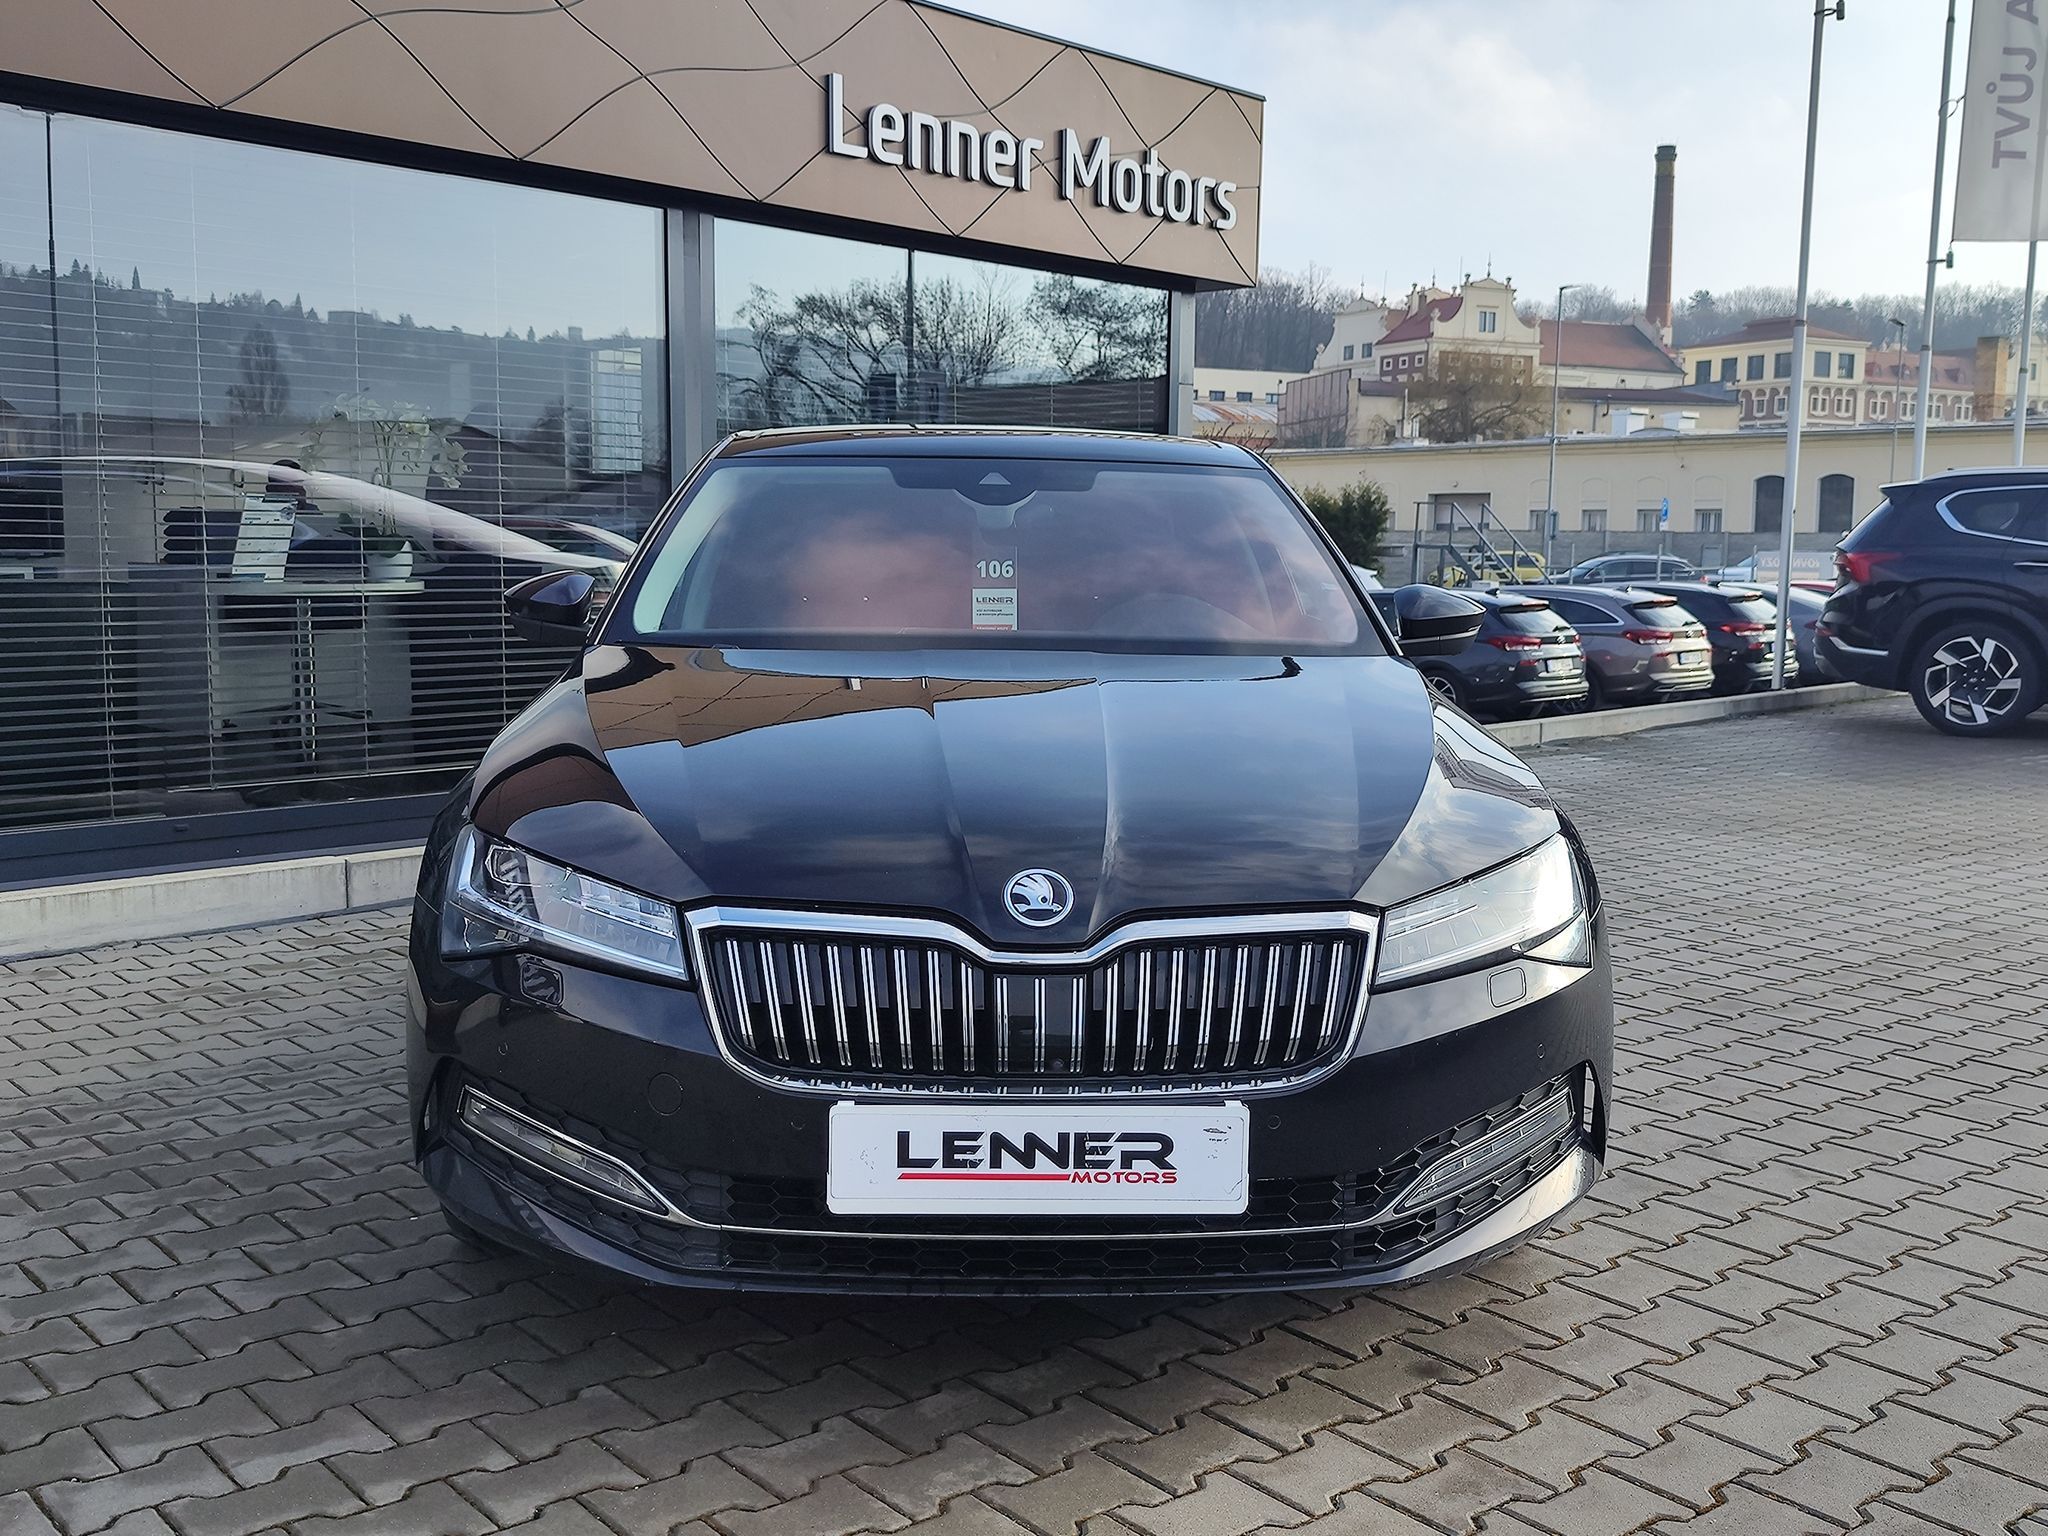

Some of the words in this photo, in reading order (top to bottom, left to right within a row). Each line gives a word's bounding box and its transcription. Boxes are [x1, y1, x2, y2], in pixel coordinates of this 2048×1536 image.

[1986, 47, 2038, 169] TVŮJ
[828, 73, 1044, 191] Lenner
[1060, 128, 1238, 230] Motors
[976, 560, 1014, 578] 106
[897, 1131, 1177, 1170] LENNER
[1069, 1171, 1178, 1185] MOTORS
